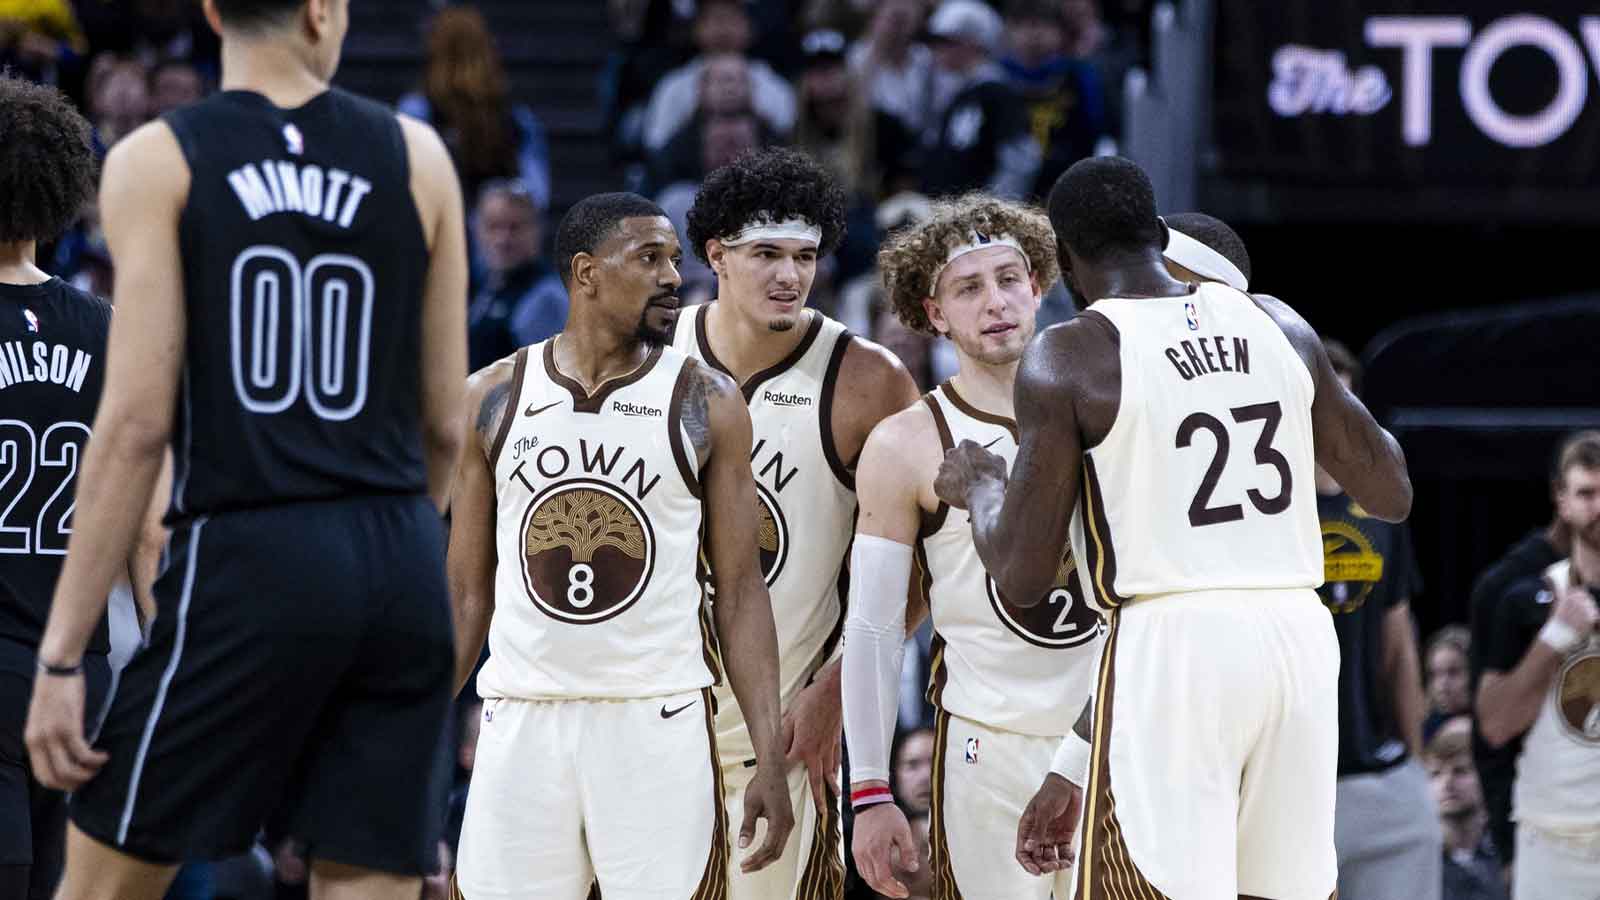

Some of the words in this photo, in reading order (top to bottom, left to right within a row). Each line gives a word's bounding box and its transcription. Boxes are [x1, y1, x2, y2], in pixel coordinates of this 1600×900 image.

[1363, 12, 1600, 148] TO
[227, 159, 373, 229] MINOTT
[230, 245, 375, 421] 00
[1164, 335, 1250, 381] GREEN
[612, 401, 663, 418] Rakuten
[763, 391, 812, 407] Rakuten
[508, 438, 662, 501] TOWN
[512, 434, 540, 460] The
[1174, 400, 1293, 528] 23
[0, 419, 94, 556] 22
[566, 563, 594, 608] 8
[1048, 590, 1078, 634] 2
